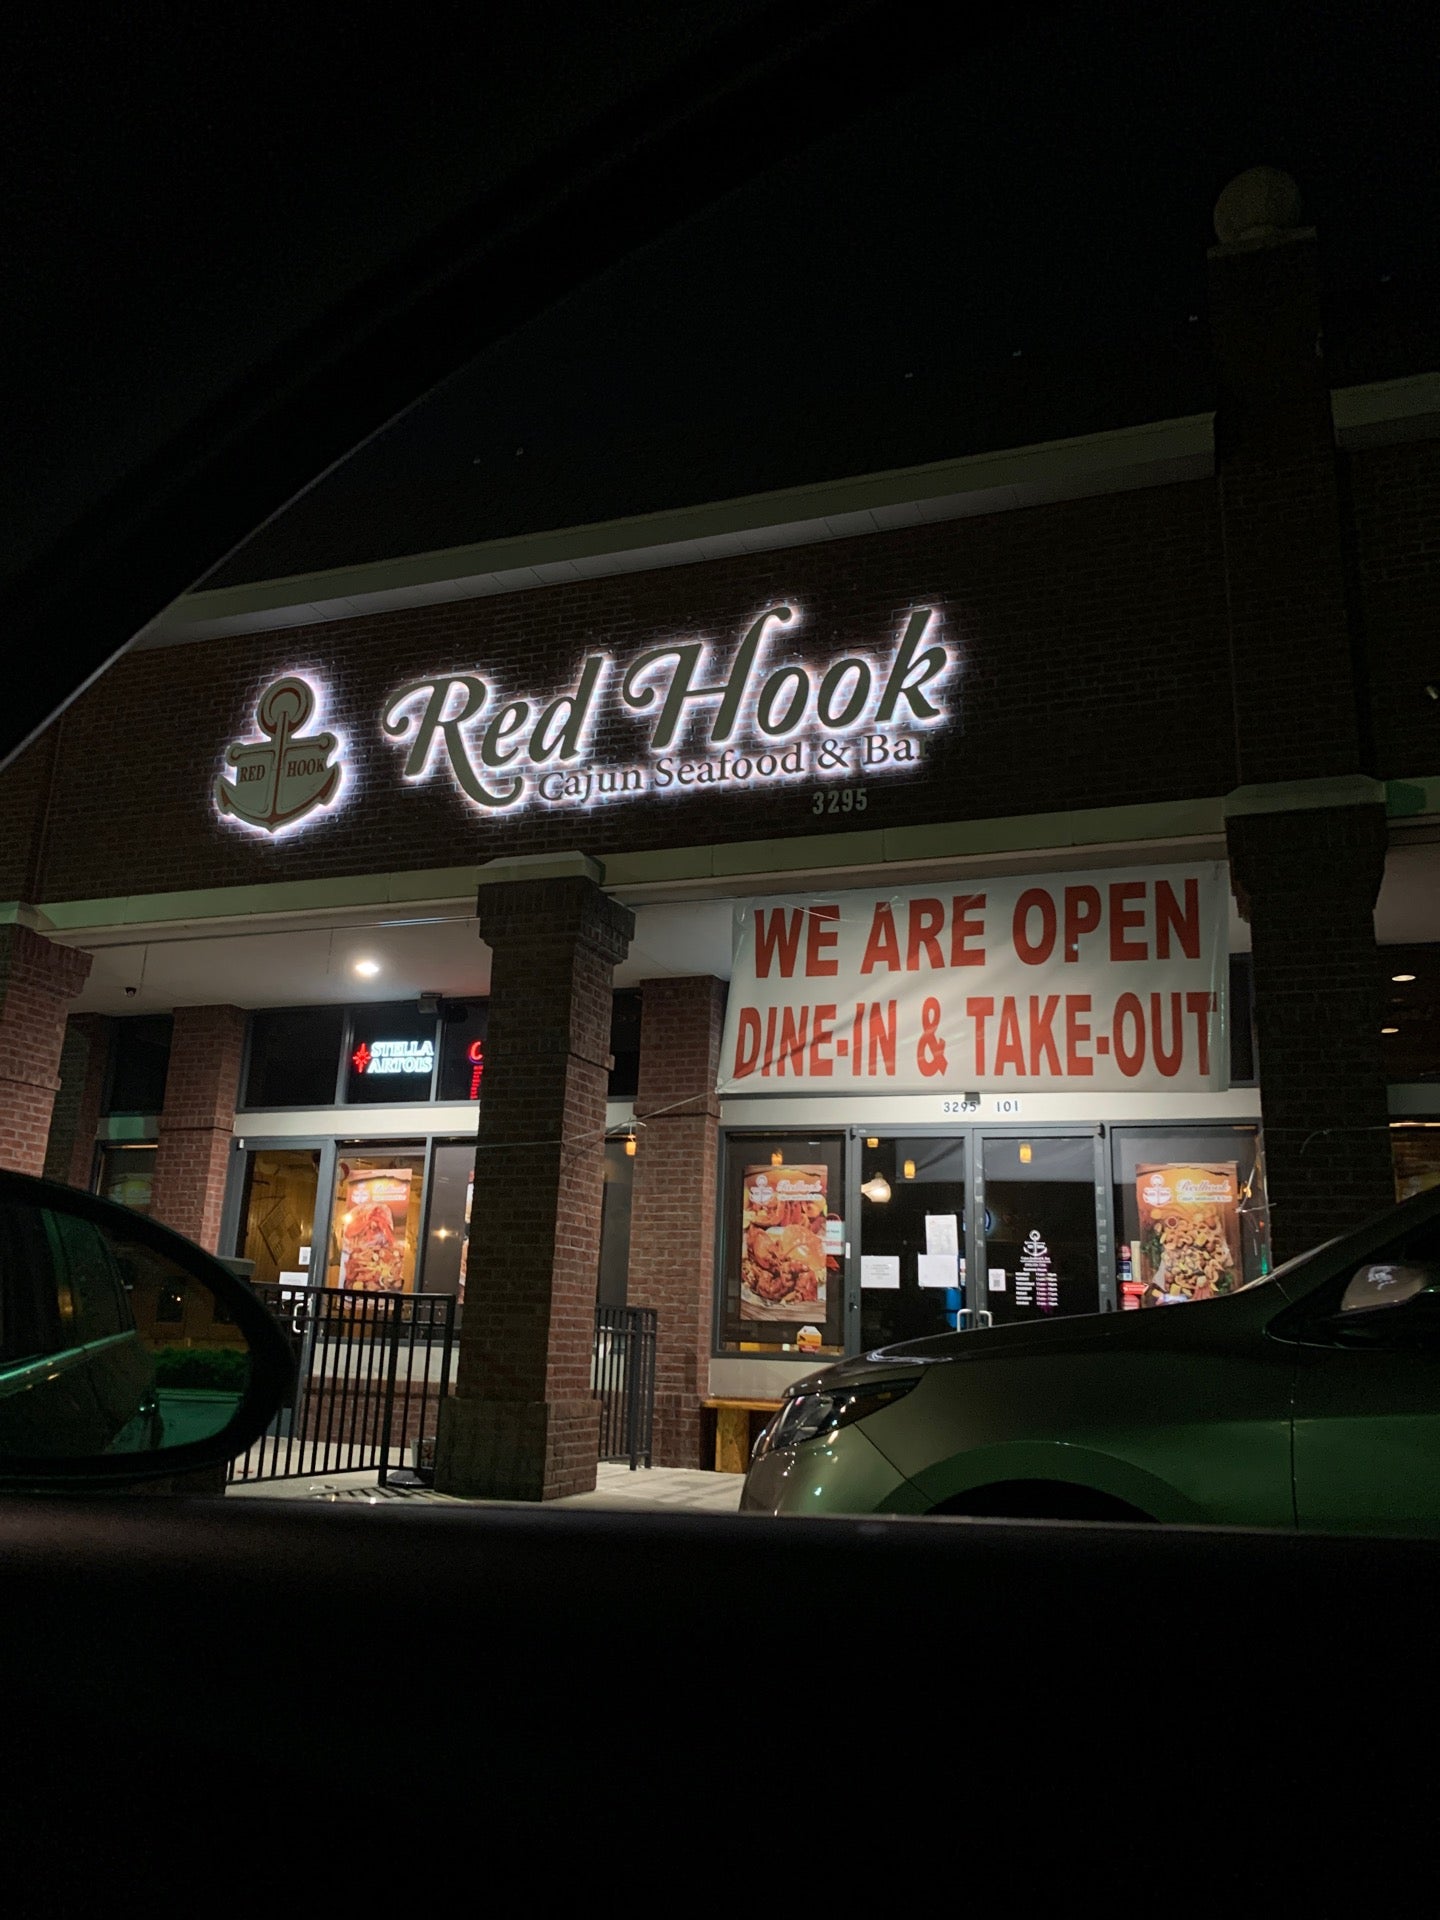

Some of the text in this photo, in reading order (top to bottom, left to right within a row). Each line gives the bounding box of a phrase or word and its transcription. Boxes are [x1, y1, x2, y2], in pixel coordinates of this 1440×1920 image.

[383, 606, 948, 807] Red Hook
[239, 758, 326, 783] RED HOOK
[537, 766, 645, 804] Cajun
[654, 740, 805, 788] Seafood
[816, 740, 852, 771] &
[811, 788, 868, 815] 3295
[753, 877, 1202, 978] WE ARE OPEN
[370, 1040, 434, 1058] STELLA
[733, 992, 1218, 1079] DINE-IN & TAKE-OUT
[367, 1056, 433, 1074] ARTOIS
[943, 1100, 1019, 1113] 3295 101
